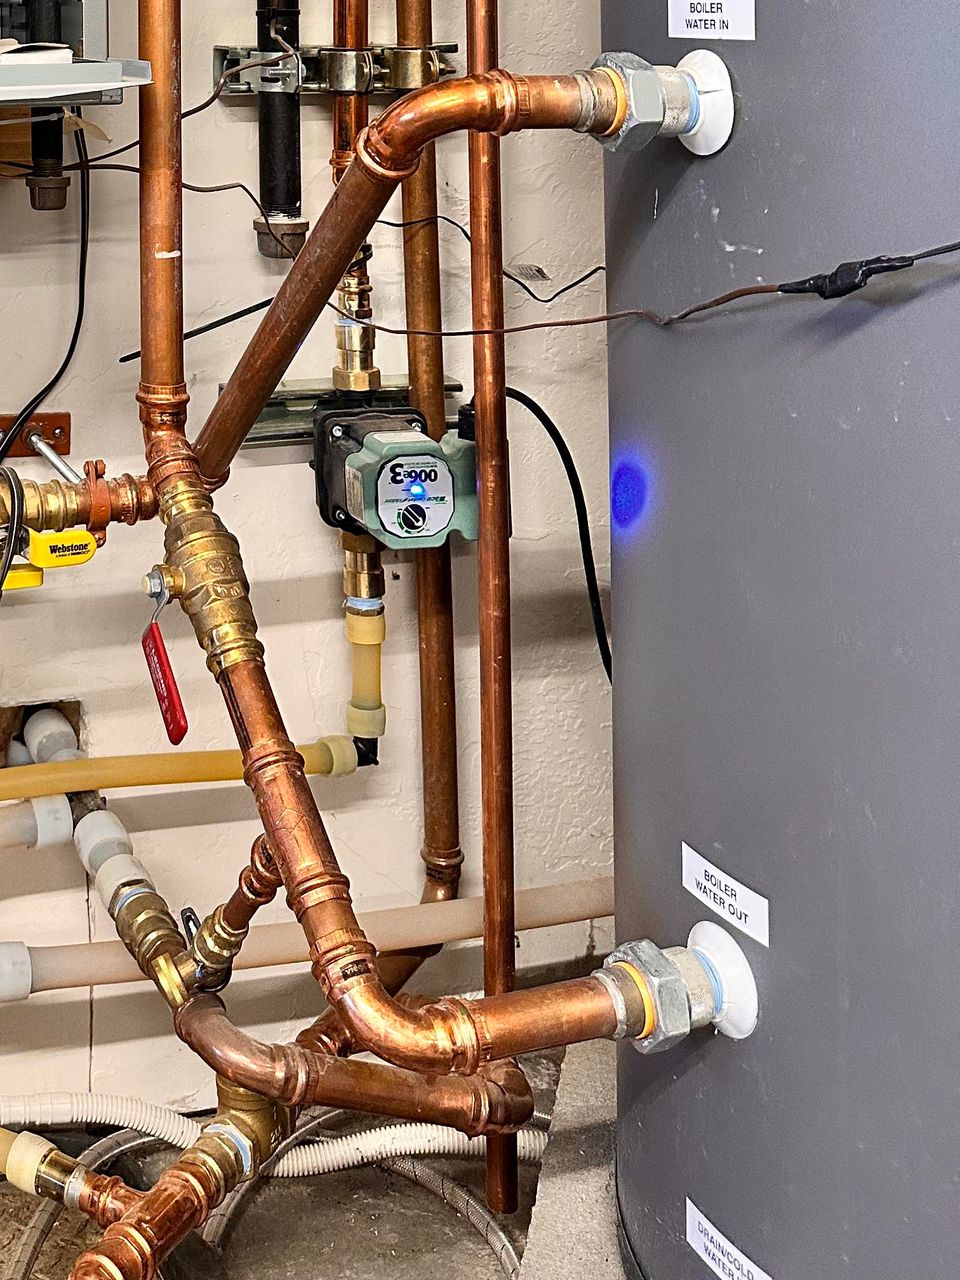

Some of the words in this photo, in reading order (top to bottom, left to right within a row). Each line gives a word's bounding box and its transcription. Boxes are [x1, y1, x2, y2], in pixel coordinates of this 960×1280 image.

[689, 2, 723, 14] BOILER
[685, 18, 716, 30] WATER
[719, 19, 729, 30] IN
[48, 542, 90, 555] Webstone
[704, 869, 737, 902] BOILER
[695, 877, 726, 910] WATER
[728, 903, 749, 924] OUT
[703, 1241, 735, 1280] WATER
